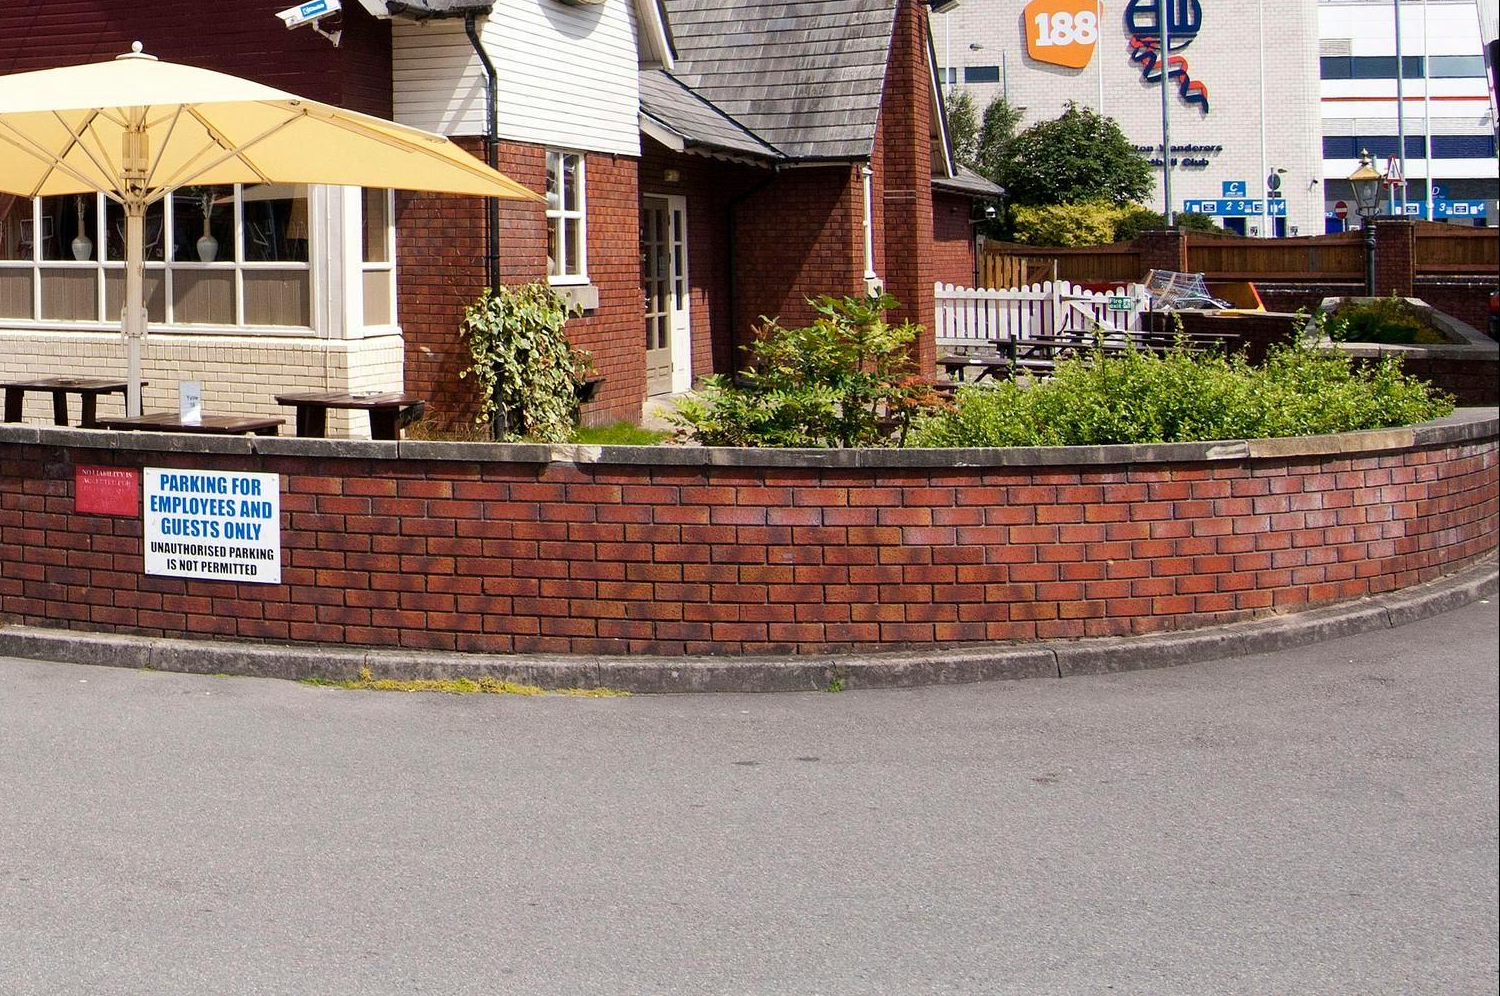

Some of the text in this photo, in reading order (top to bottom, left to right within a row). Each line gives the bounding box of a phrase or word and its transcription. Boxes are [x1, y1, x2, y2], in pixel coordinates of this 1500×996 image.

[1035, 10, 1097, 46] 188
[1181, 157, 1210, 167] Club
[1229, 182, 1239, 192] C
[1225, 201, 1232, 211] 2
[1237, 201, 1245, 210] 3
[1438, 202, 1446, 212] 3
[1477, 202, 1485, 211] 4
[160, 474, 261, 496] PARKING FOR
[150, 495, 272, 519] EMPLOYEES AND
[161, 517, 262, 541] GUESTS ONLY
[150, 541, 274, 560] UNAUTHORISED PARKING
[166, 558, 257, 576] IS NOT PERMITTED
